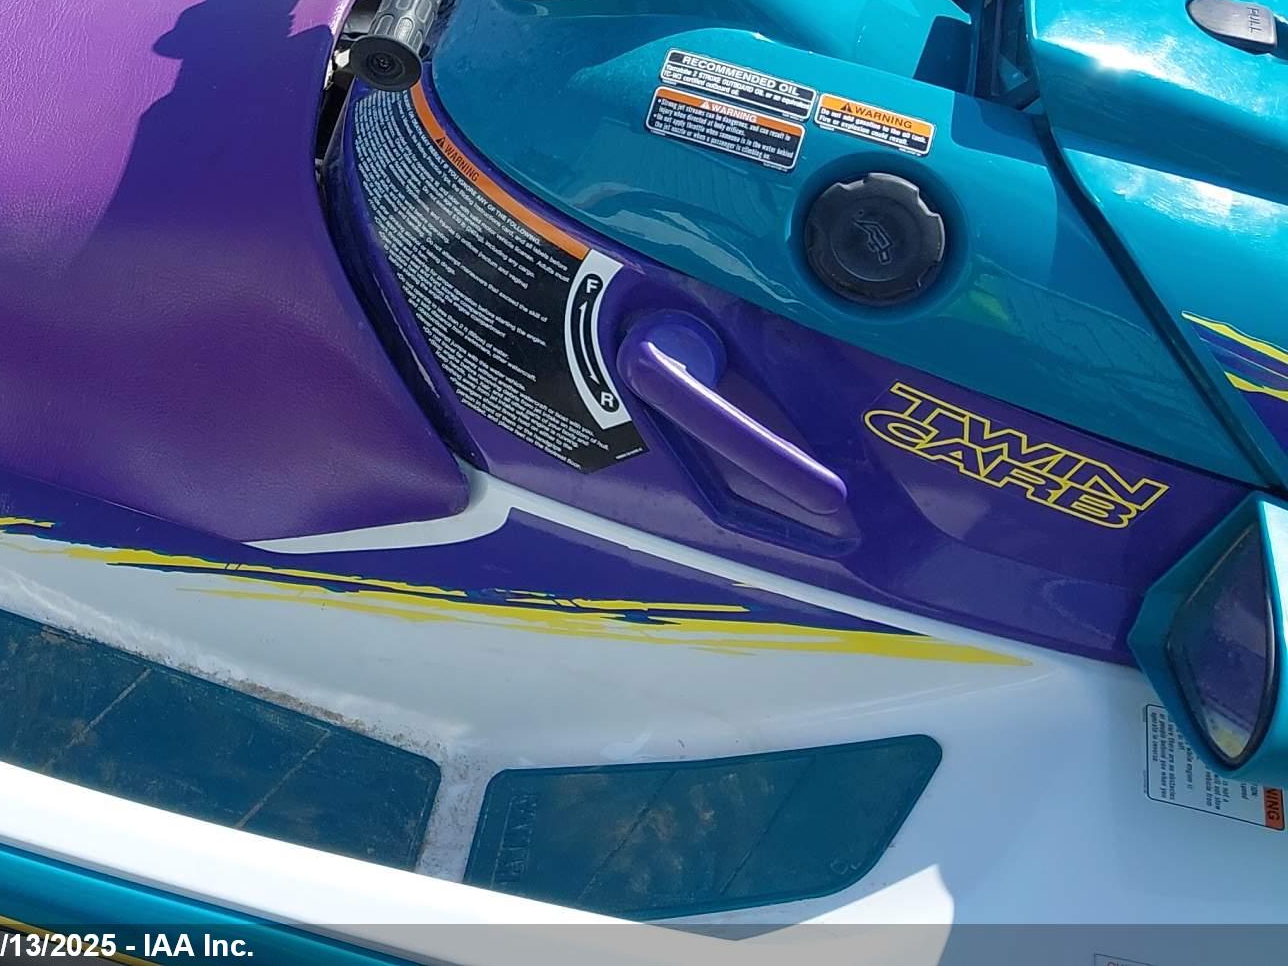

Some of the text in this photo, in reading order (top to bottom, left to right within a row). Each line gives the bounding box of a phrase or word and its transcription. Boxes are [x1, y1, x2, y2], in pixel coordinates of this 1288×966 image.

[1246, 6, 1262, 34] PULL
[682, 56, 800, 96] RECOMMENDED OIL
[697, 72, 721, 84] STROKE
[721, 78, 754, 93] OUTBOARD
[705, 80, 731, 93] outboard
[710, 103, 757, 123] WARNING
[818, 114, 831, 123] Fire
[832, 118, 840, 126] or
[840, 120, 870, 134] explosion
[870, 129, 889, 139] could
[820, 107, 830, 115] Do
[830, 110, 841, 119] not
[842, 113, 855, 122] add
[855, 117, 881, 130] gasoline
[881, 124, 890, 132] to
[889, 127, 901, 136] the
[901, 130, 911, 138] oil
[854, 105, 913, 129] WARNING
[408, 109, 414, 119] OR
[411, 116, 423, 136] DEATH
[420, 133, 430, 147] MAY
[428, 144, 444, 165] RESULT
[442, 162, 448, 170] IF
[446, 167, 459, 180] YOU
[457, 177, 477, 196] IGNORE
[476, 193, 488, 205] ANY
[486, 202, 496, 212] OF
[494, 209, 507, 221] THE
[443, 144, 480, 182] WARNING
[495, 232, 515, 249] vehicle
[535, 260, 555, 274] Adults
[553, 270, 570, 283] must
[514, 234, 526, 244] and
[524, 241, 533, 249] all
[531, 245, 550, 259] labels
[548, 256, 568, 271] before
[586, 279, 599, 294] F
[600, 391, 615, 408] R
[890, 381, 1171, 512] TWIN
[863, 409, 1138, 530] CARB
